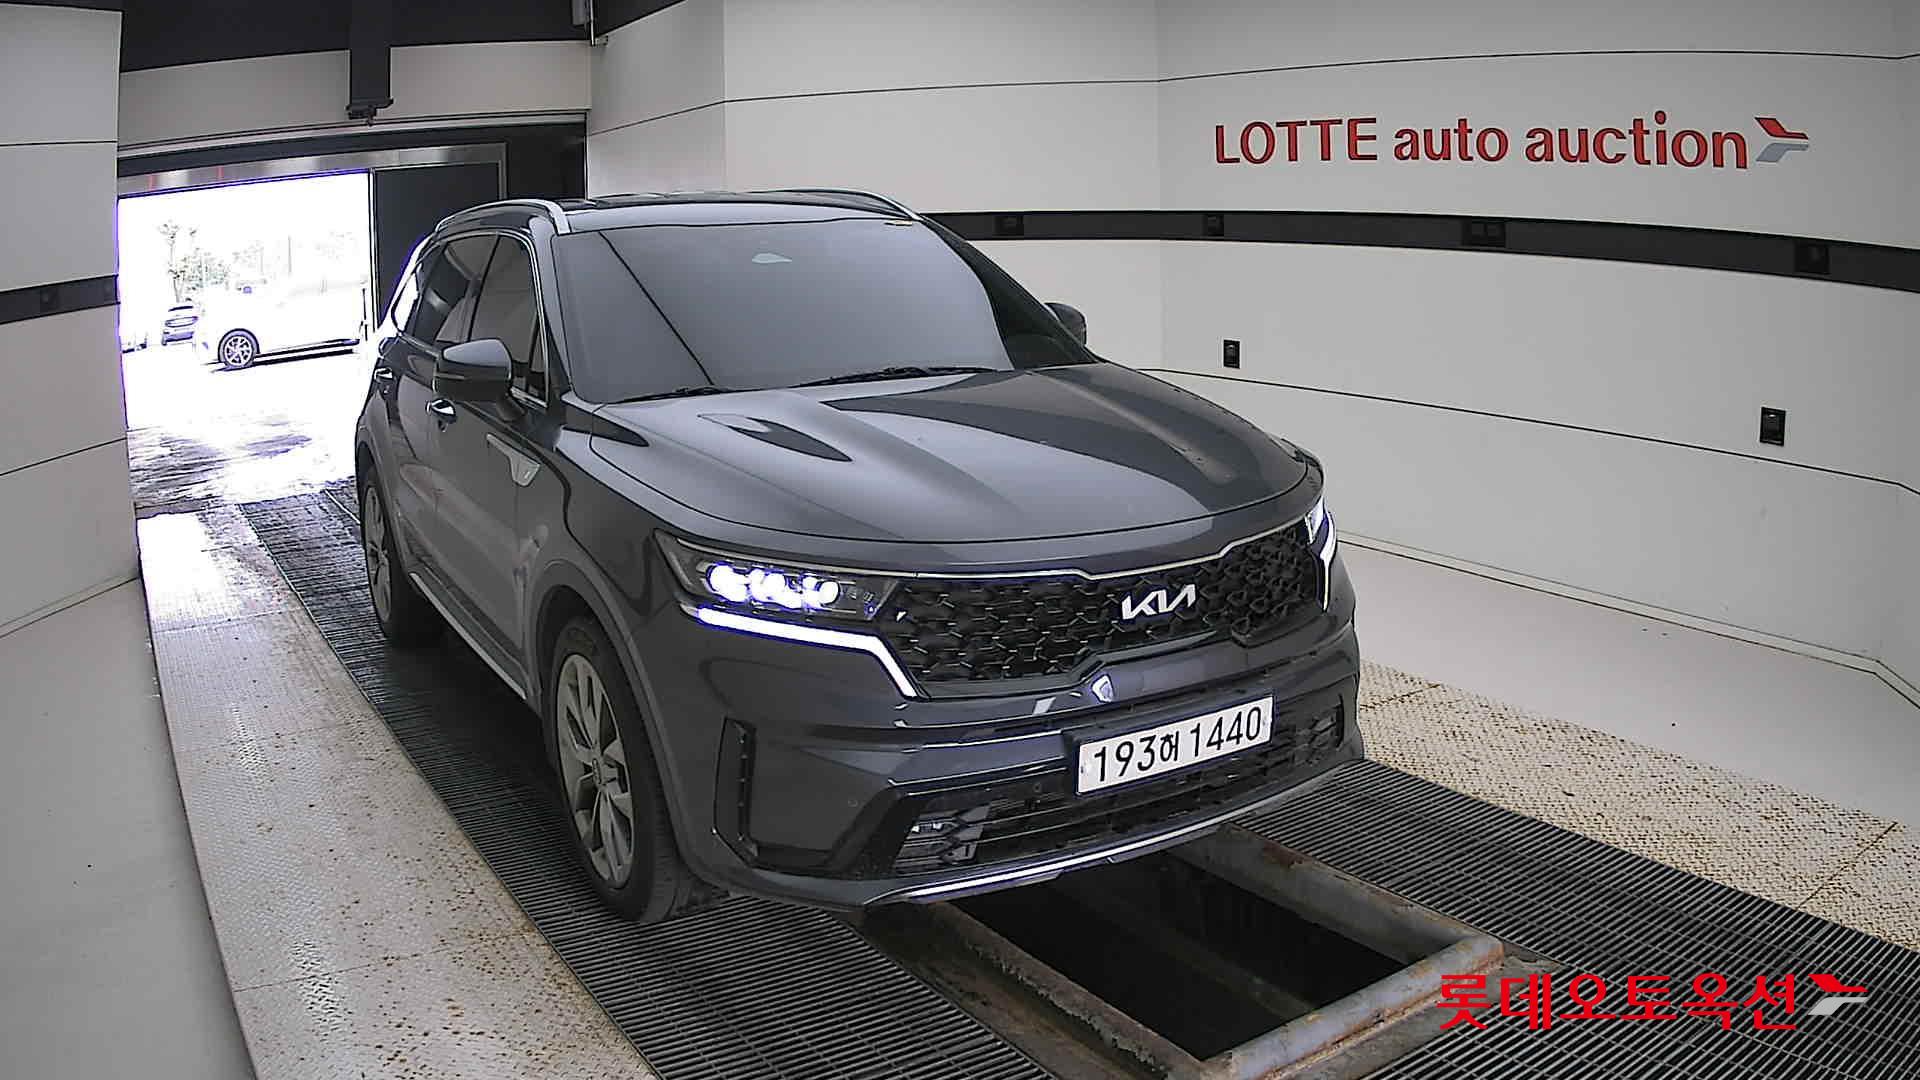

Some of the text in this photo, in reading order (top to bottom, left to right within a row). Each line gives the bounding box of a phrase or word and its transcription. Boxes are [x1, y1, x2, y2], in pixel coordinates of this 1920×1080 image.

[1214, 110, 1748, 169] LOTTE auto auction
[1121, 584, 1196, 619] KIA
[1094, 707, 1262, 782] 193허 1440
